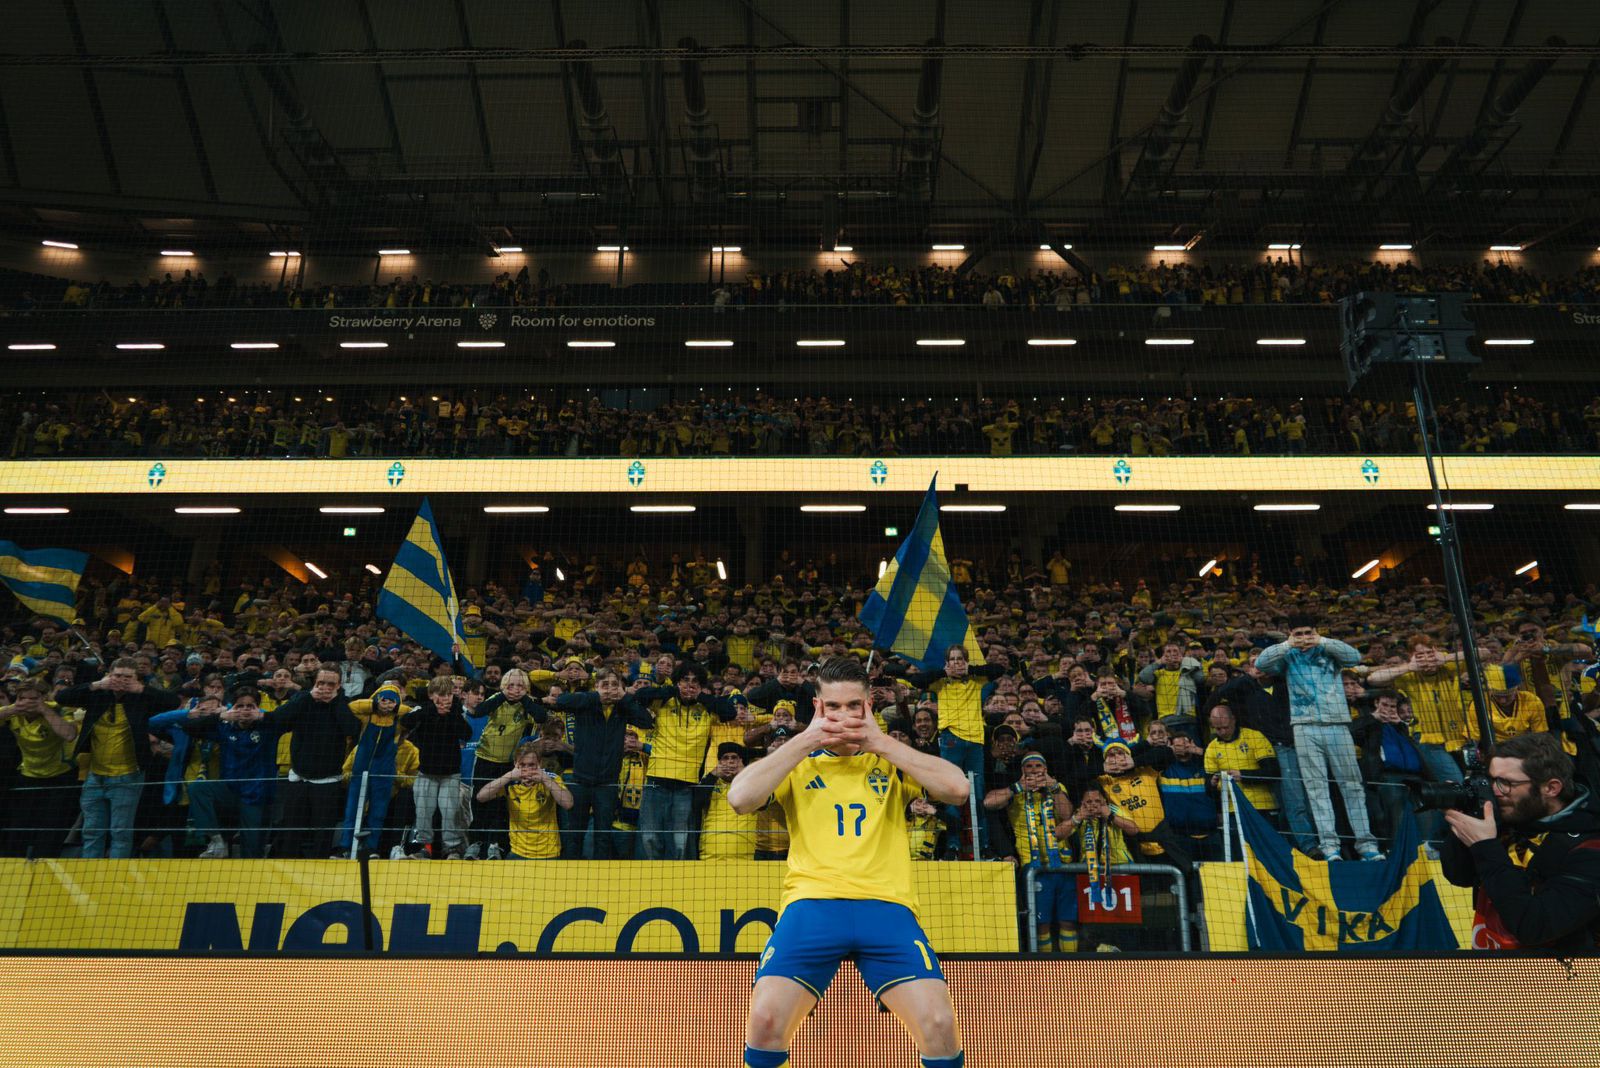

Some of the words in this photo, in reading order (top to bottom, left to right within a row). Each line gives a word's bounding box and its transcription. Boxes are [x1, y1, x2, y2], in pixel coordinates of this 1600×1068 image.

[329, 315, 413, 330] Strawberry
[416, 315, 461, 328] Arena
[511, 315, 555, 327] Room
[558, 314, 580, 327] for
[583, 314, 656, 327] emotions
[834, 803, 866, 836] 17
[1083, 887, 1132, 911] 101
